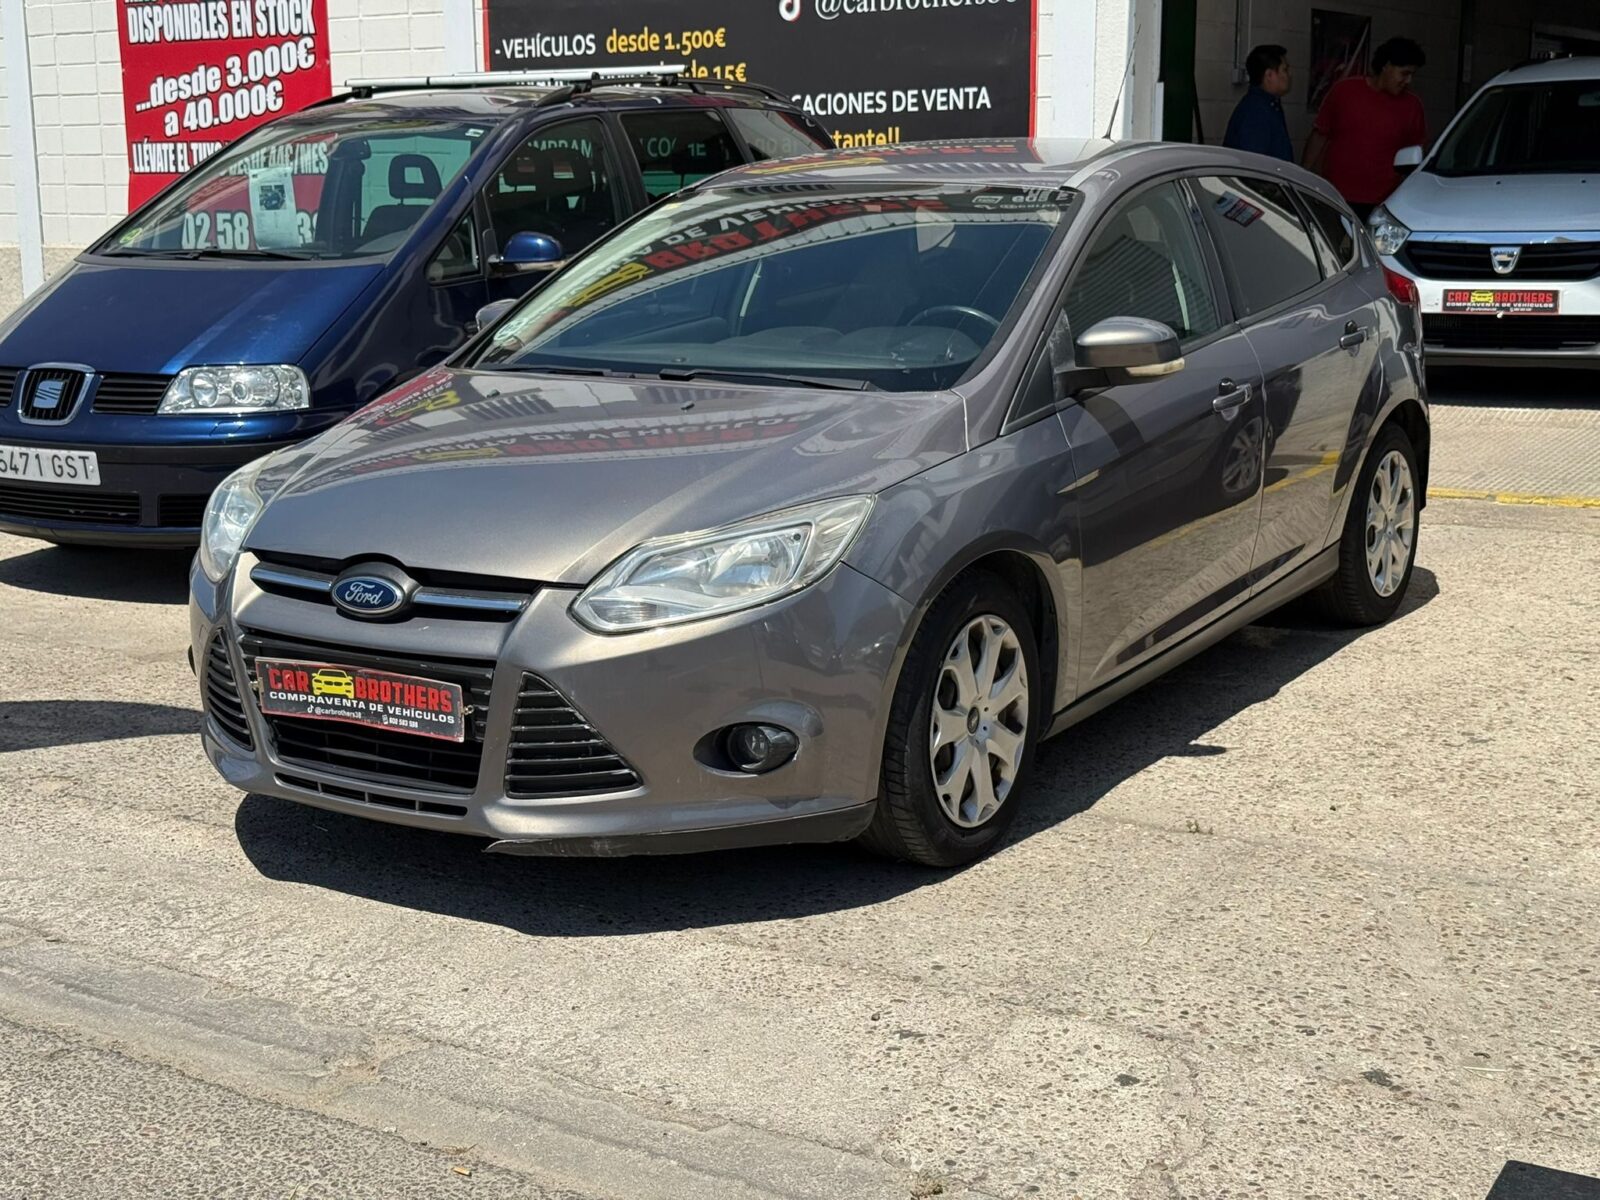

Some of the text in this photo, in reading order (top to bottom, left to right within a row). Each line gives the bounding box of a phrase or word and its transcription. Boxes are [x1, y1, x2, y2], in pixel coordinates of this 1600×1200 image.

[127, 0, 316, 44] DISPONIBLES EN STOCK
[606, 29, 660, 53] desde
[664, 28, 726, 56] 1.500€
[226, 37, 316, 88] 3.000€
[713, 61, 747, 89] 15€
[164, 80, 284, 137] a 40.000€
[892, 89, 919, 112] DE
[921, 86, 992, 111] VENTA
[832, 126, 900, 149] tante!!
[132, 137, 177, 173] LLÉVATE
[176, 142, 191, 173] EL
[190, 142, 223, 166] TU
[216, 210, 250, 250] 58
[1447, 291, 1553, 303] CAR BROTHERS
[52, 454, 89, 479] GST
[344, 581, 383, 606] Ford
[268, 668, 452, 713] CAR BROTHERS
[269, 691, 455, 725] COMPRAVENTA DE VEHÍCULOS
